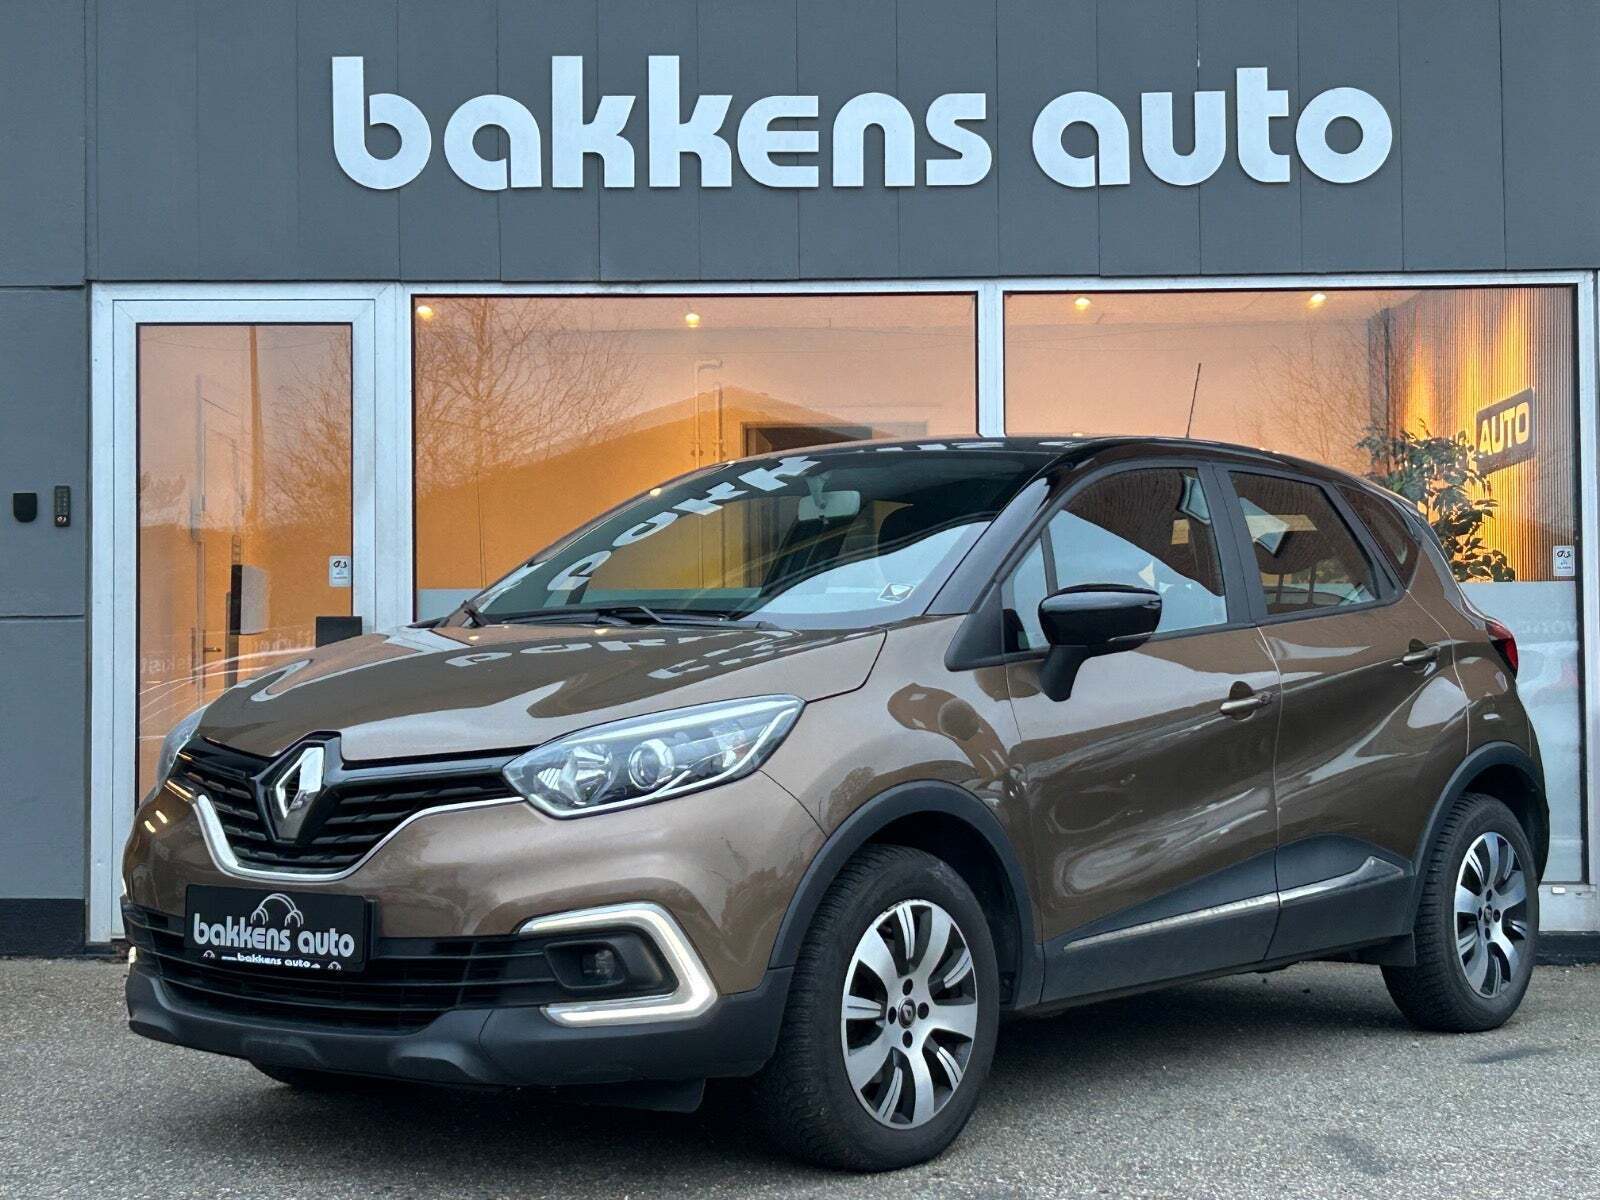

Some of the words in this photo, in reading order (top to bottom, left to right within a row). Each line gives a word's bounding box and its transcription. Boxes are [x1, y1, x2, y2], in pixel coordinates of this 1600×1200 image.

[331, 56, 993, 191] bakkens
[1032, 67, 1393, 189] auto
[1481, 402, 1529, 455] AUTO
[194, 913, 290, 951] bakkens
[298, 928, 355, 957] auto
